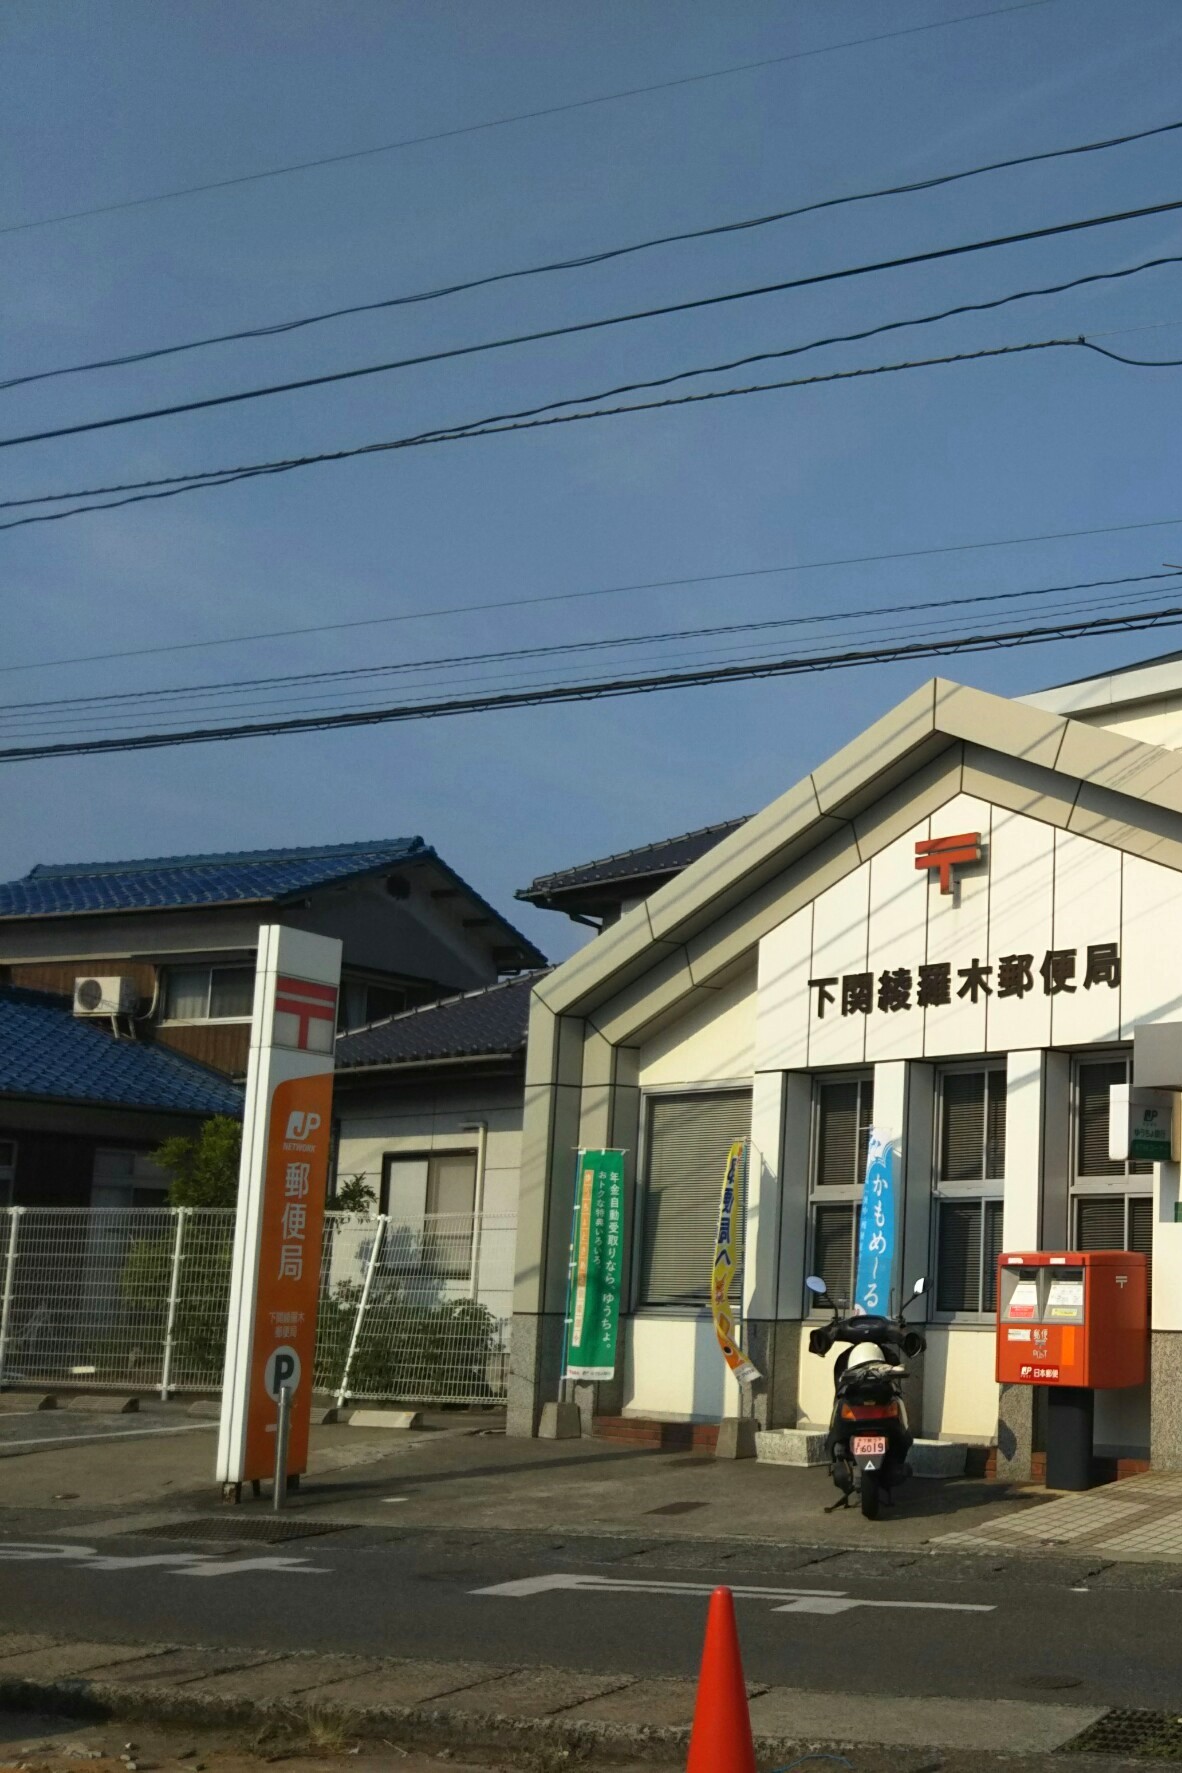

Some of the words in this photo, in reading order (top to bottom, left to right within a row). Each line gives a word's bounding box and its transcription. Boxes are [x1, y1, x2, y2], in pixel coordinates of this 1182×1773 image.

[808, 942, 1121, 1019] 下関綾羅木郵便局
[282, 1142, 316, 1153] NETWORK
[278, 1161, 310, 1282] 郵便局
[272, 1354, 295, 1395] P
[1033, 1368, 1059, 1379] 日本郵便
[861, 1442, 884, 1453] 6019
